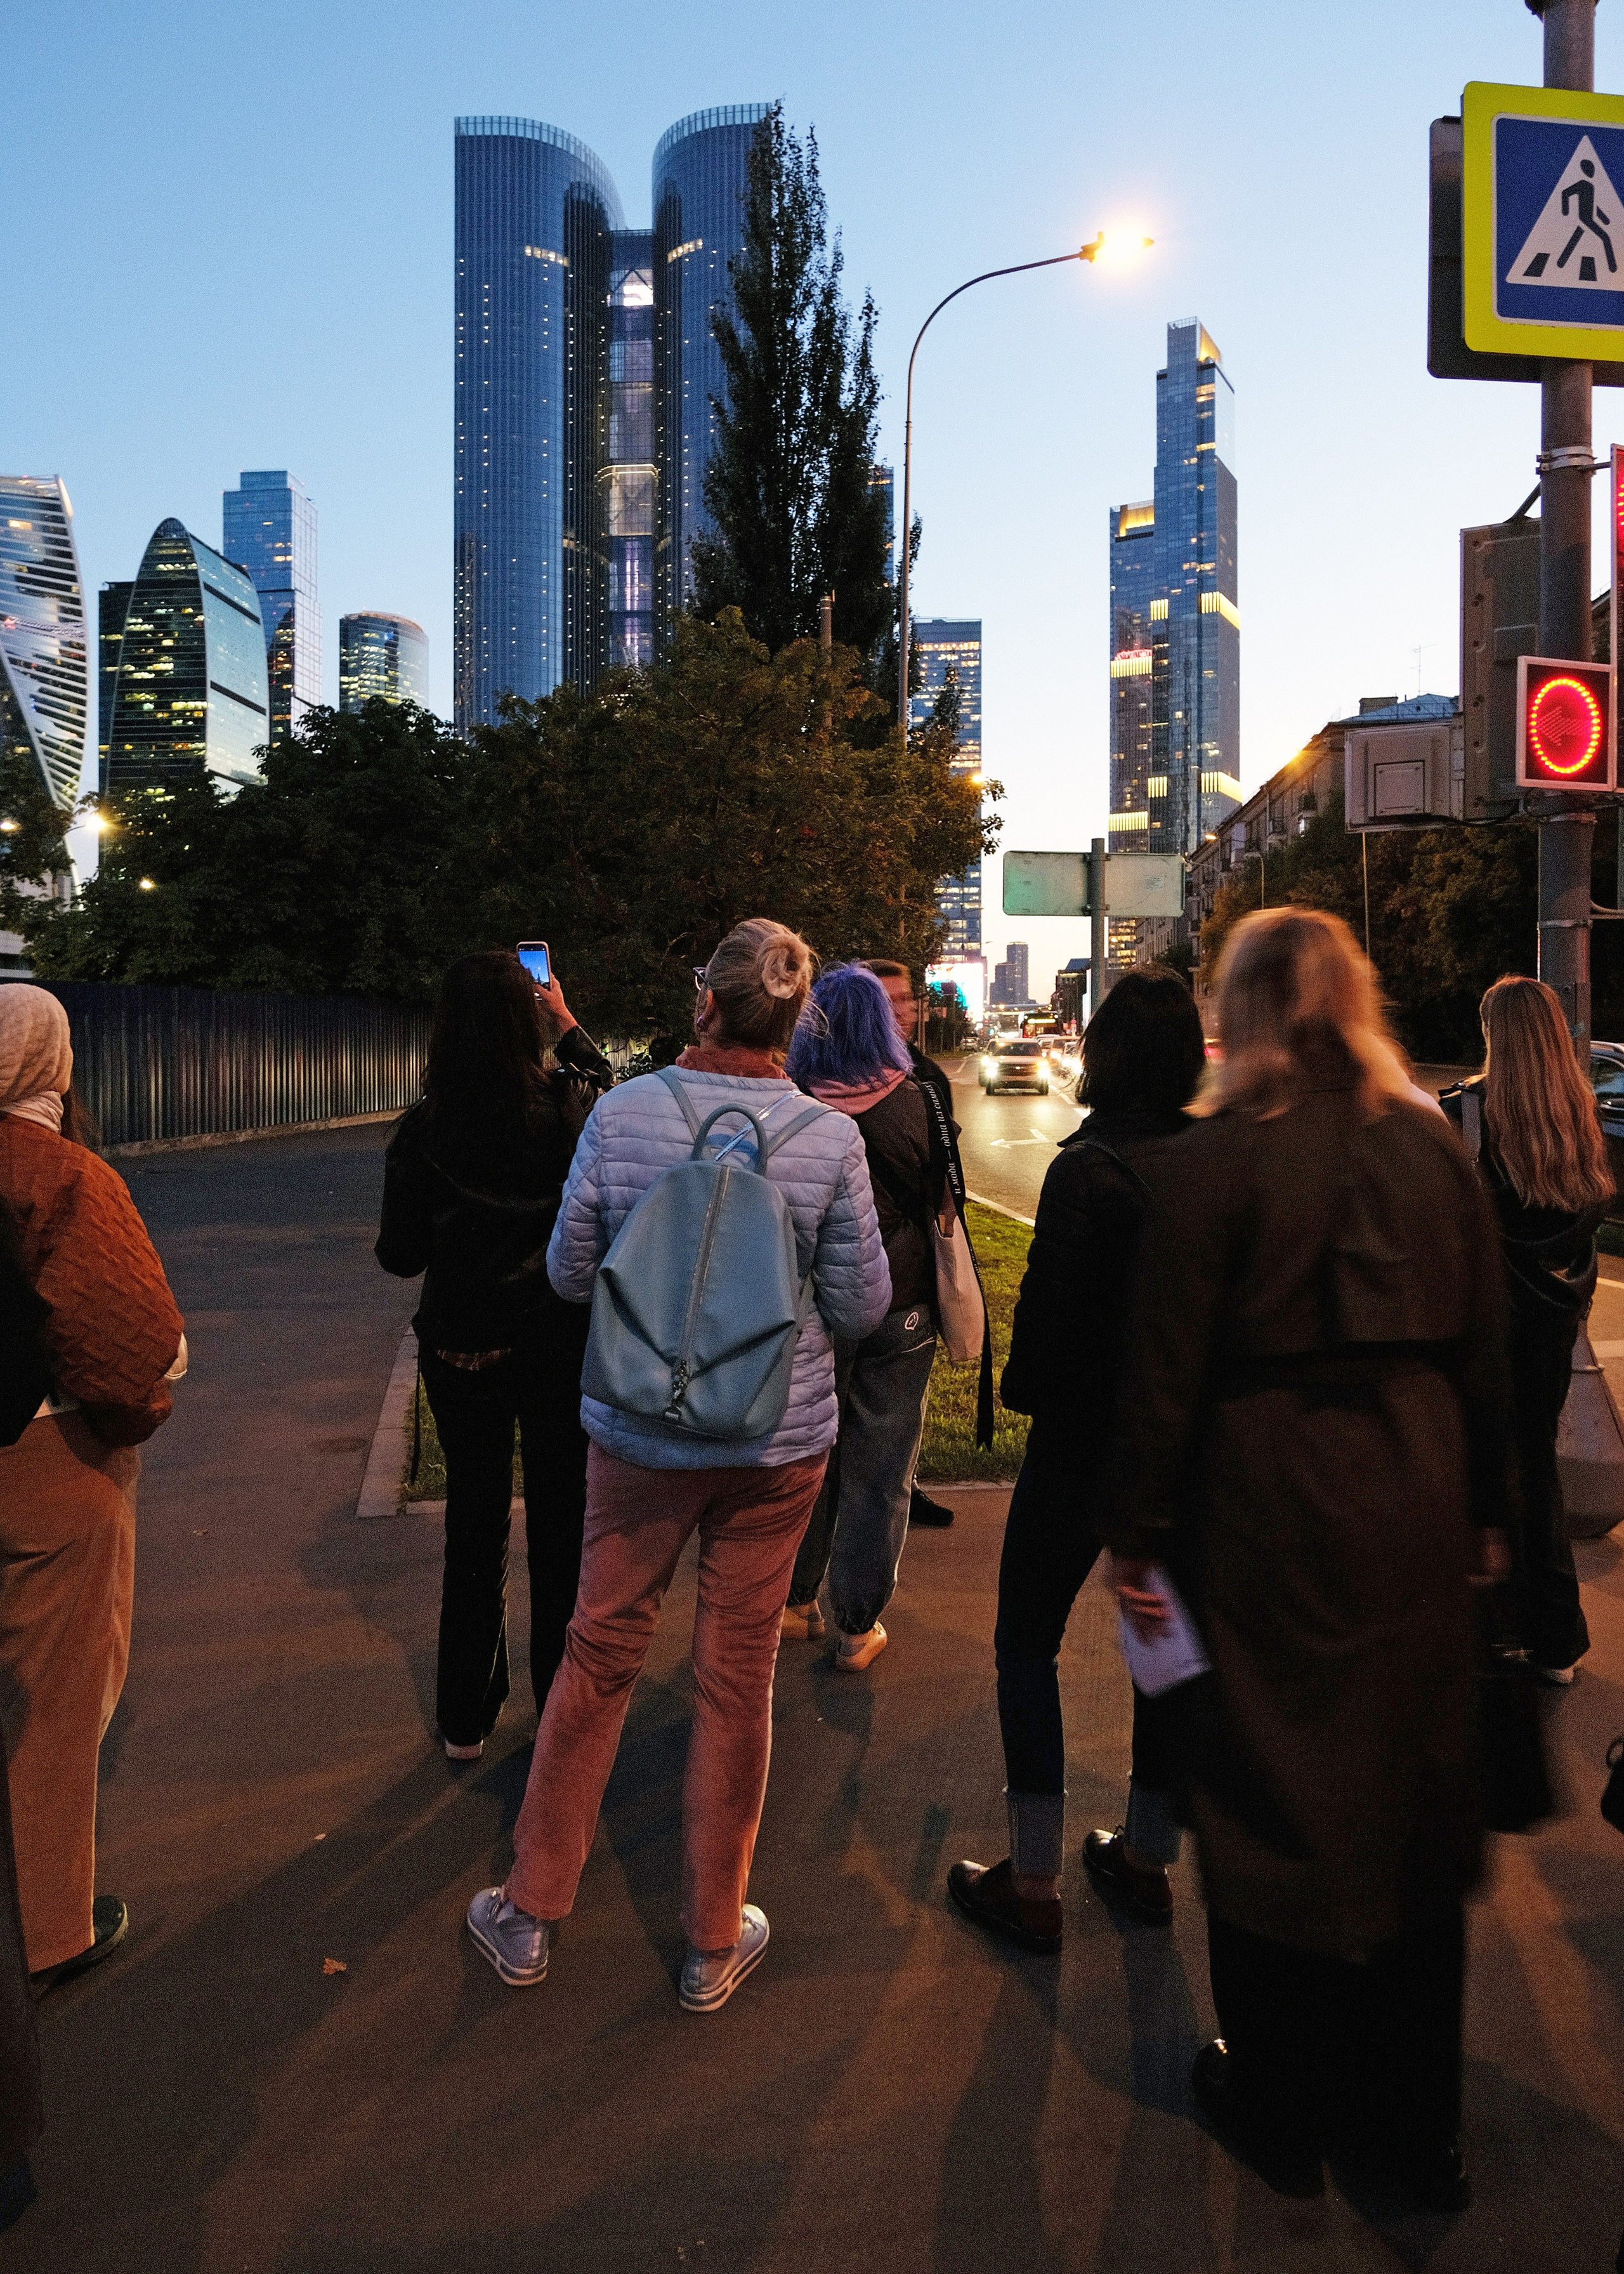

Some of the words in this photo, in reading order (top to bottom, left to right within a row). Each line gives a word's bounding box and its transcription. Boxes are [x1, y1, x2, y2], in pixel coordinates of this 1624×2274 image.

[924, 1084, 941, 1109] самых
[936, 1111, 945, 1122] из
[940, 1124, 952, 1147] одна
[948, 1162, 960, 1186] мода
